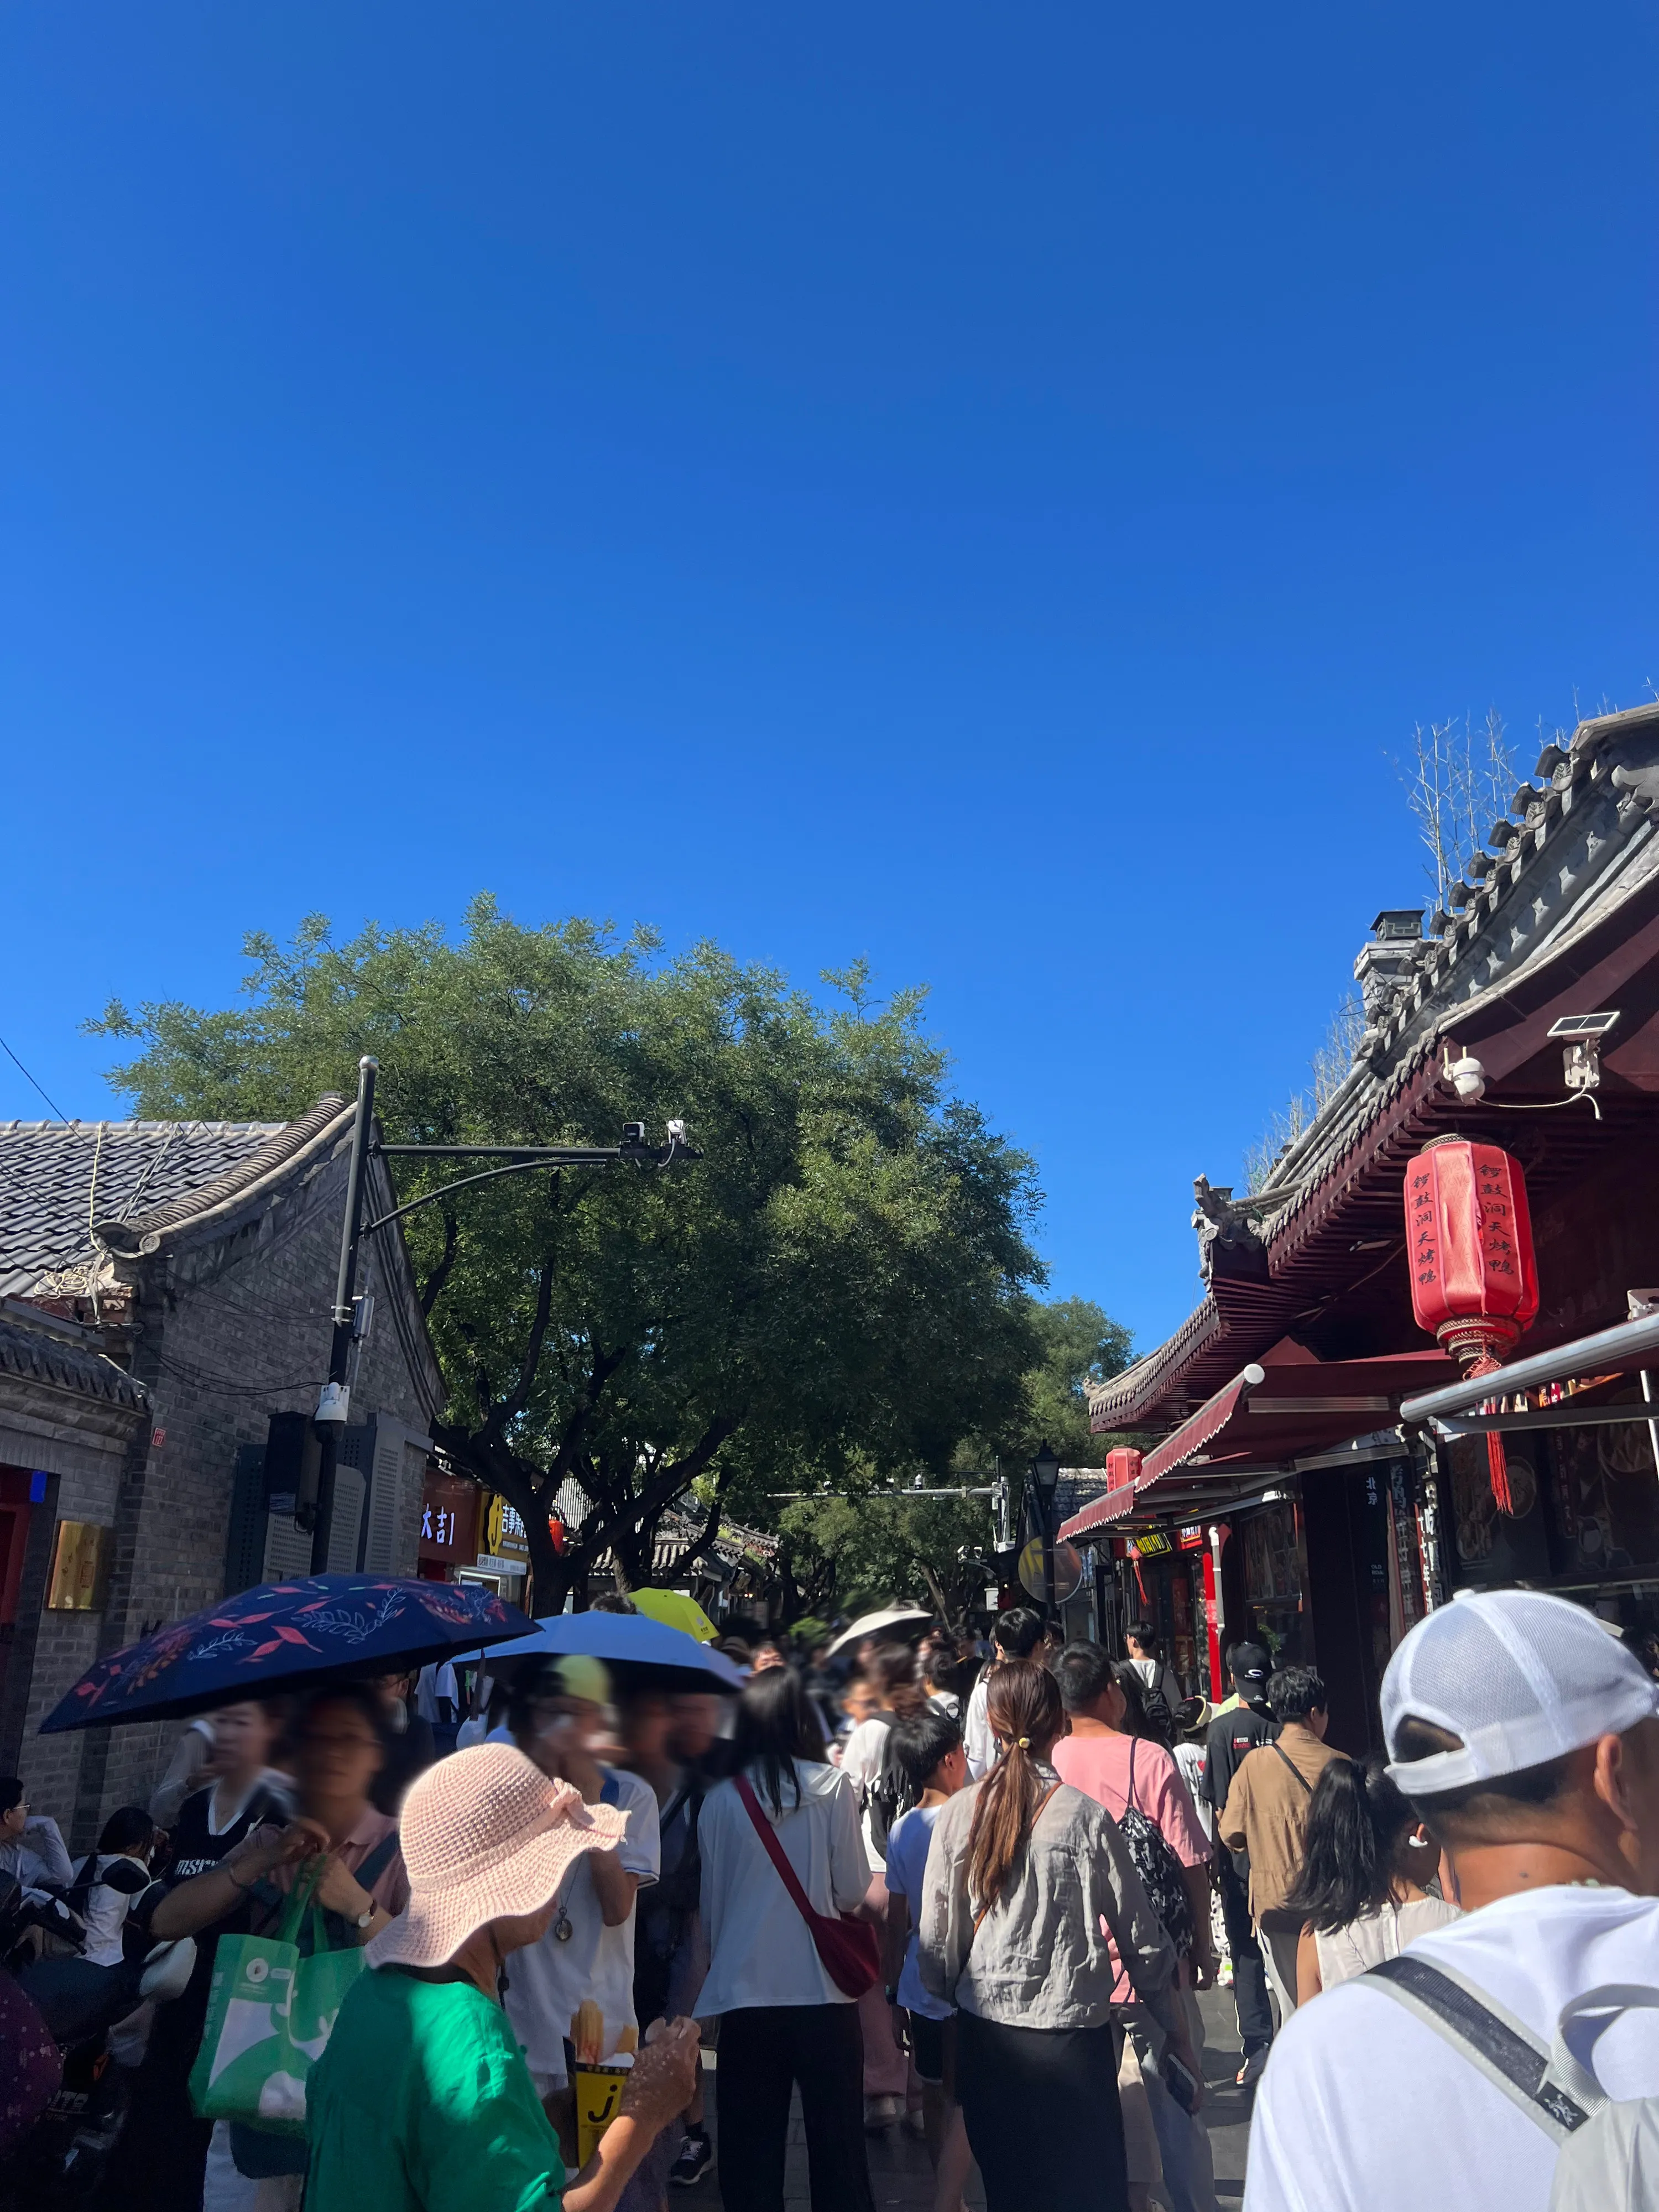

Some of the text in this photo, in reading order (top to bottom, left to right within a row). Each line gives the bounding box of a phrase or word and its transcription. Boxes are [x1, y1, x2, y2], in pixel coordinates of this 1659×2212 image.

[1411, 1173, 1436, 1285] 锣鼓洞天烤鸭
[1477, 1164, 1514, 1275] 锣鼓洞天烤鸭
